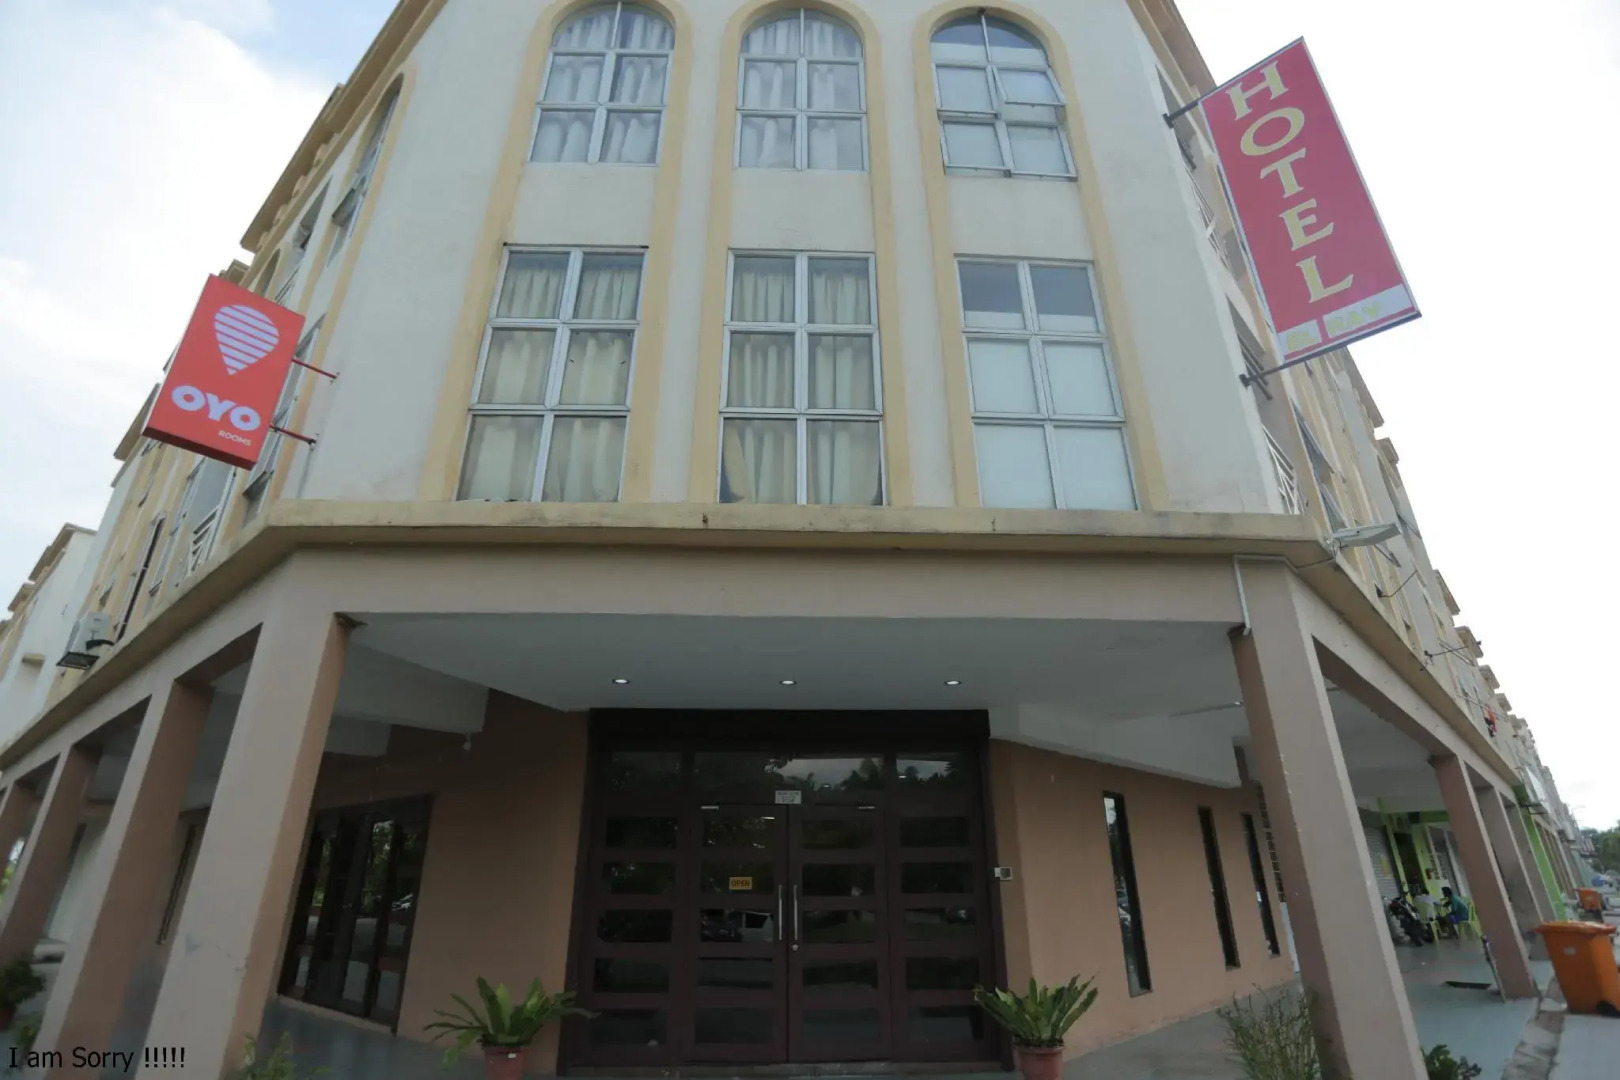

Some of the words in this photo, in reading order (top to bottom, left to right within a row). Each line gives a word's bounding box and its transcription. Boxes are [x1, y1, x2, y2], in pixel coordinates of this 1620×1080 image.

[1225, 60, 1354, 303] HOTEL
[171, 385, 261, 431] OYO
[218, 430, 252, 446] ROOMS
[731, 879, 750, 887] OPEN
